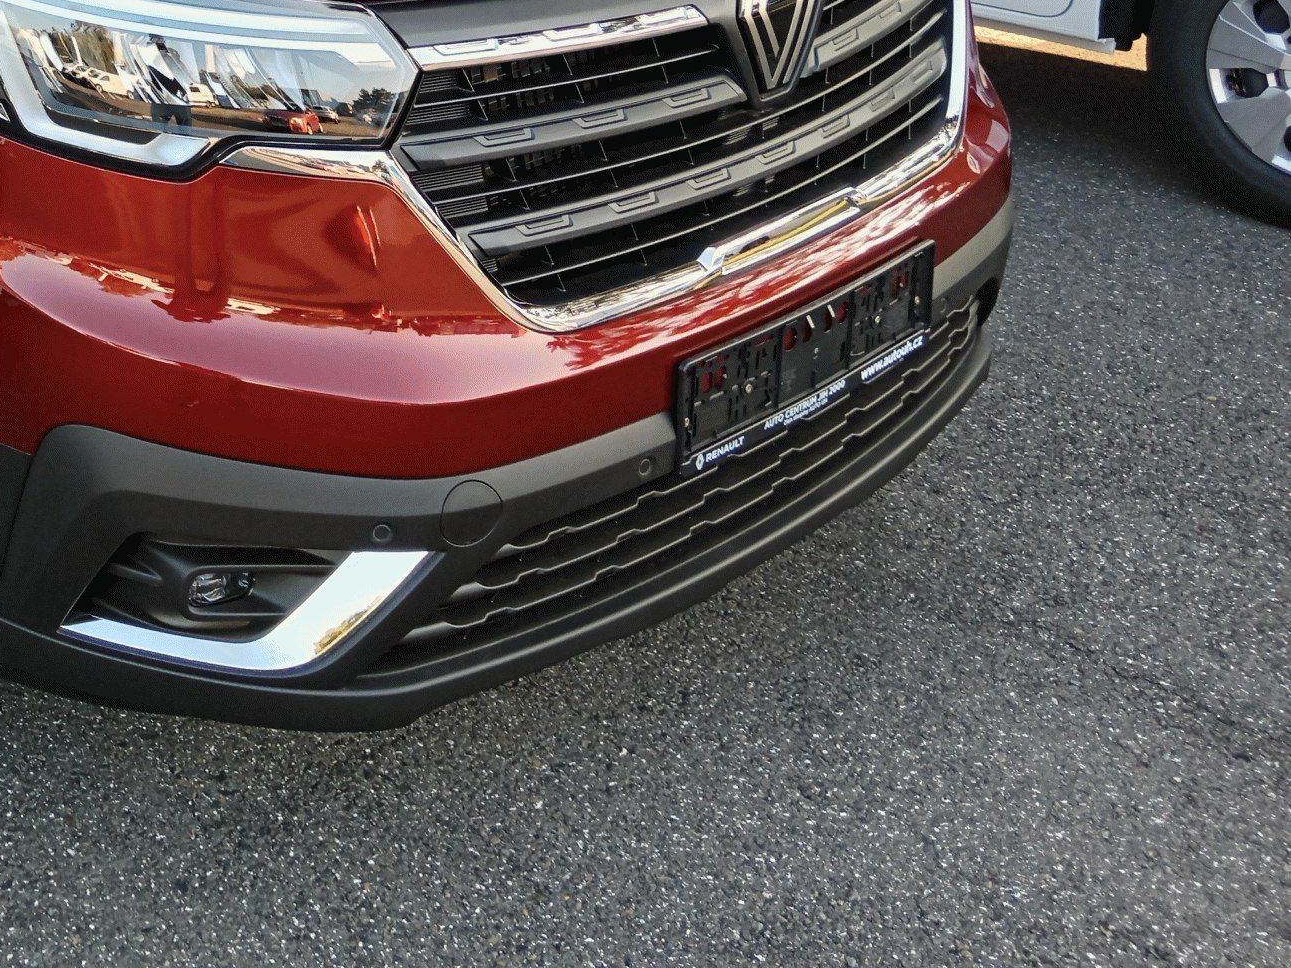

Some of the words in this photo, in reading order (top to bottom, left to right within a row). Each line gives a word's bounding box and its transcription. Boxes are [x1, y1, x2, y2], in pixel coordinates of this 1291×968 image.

[763, 413, 785, 431] AUTO
[784, 395, 818, 419] CENTRUM
[828, 379, 846, 396] 2000
[705, 435, 745, 463] RENAULT
